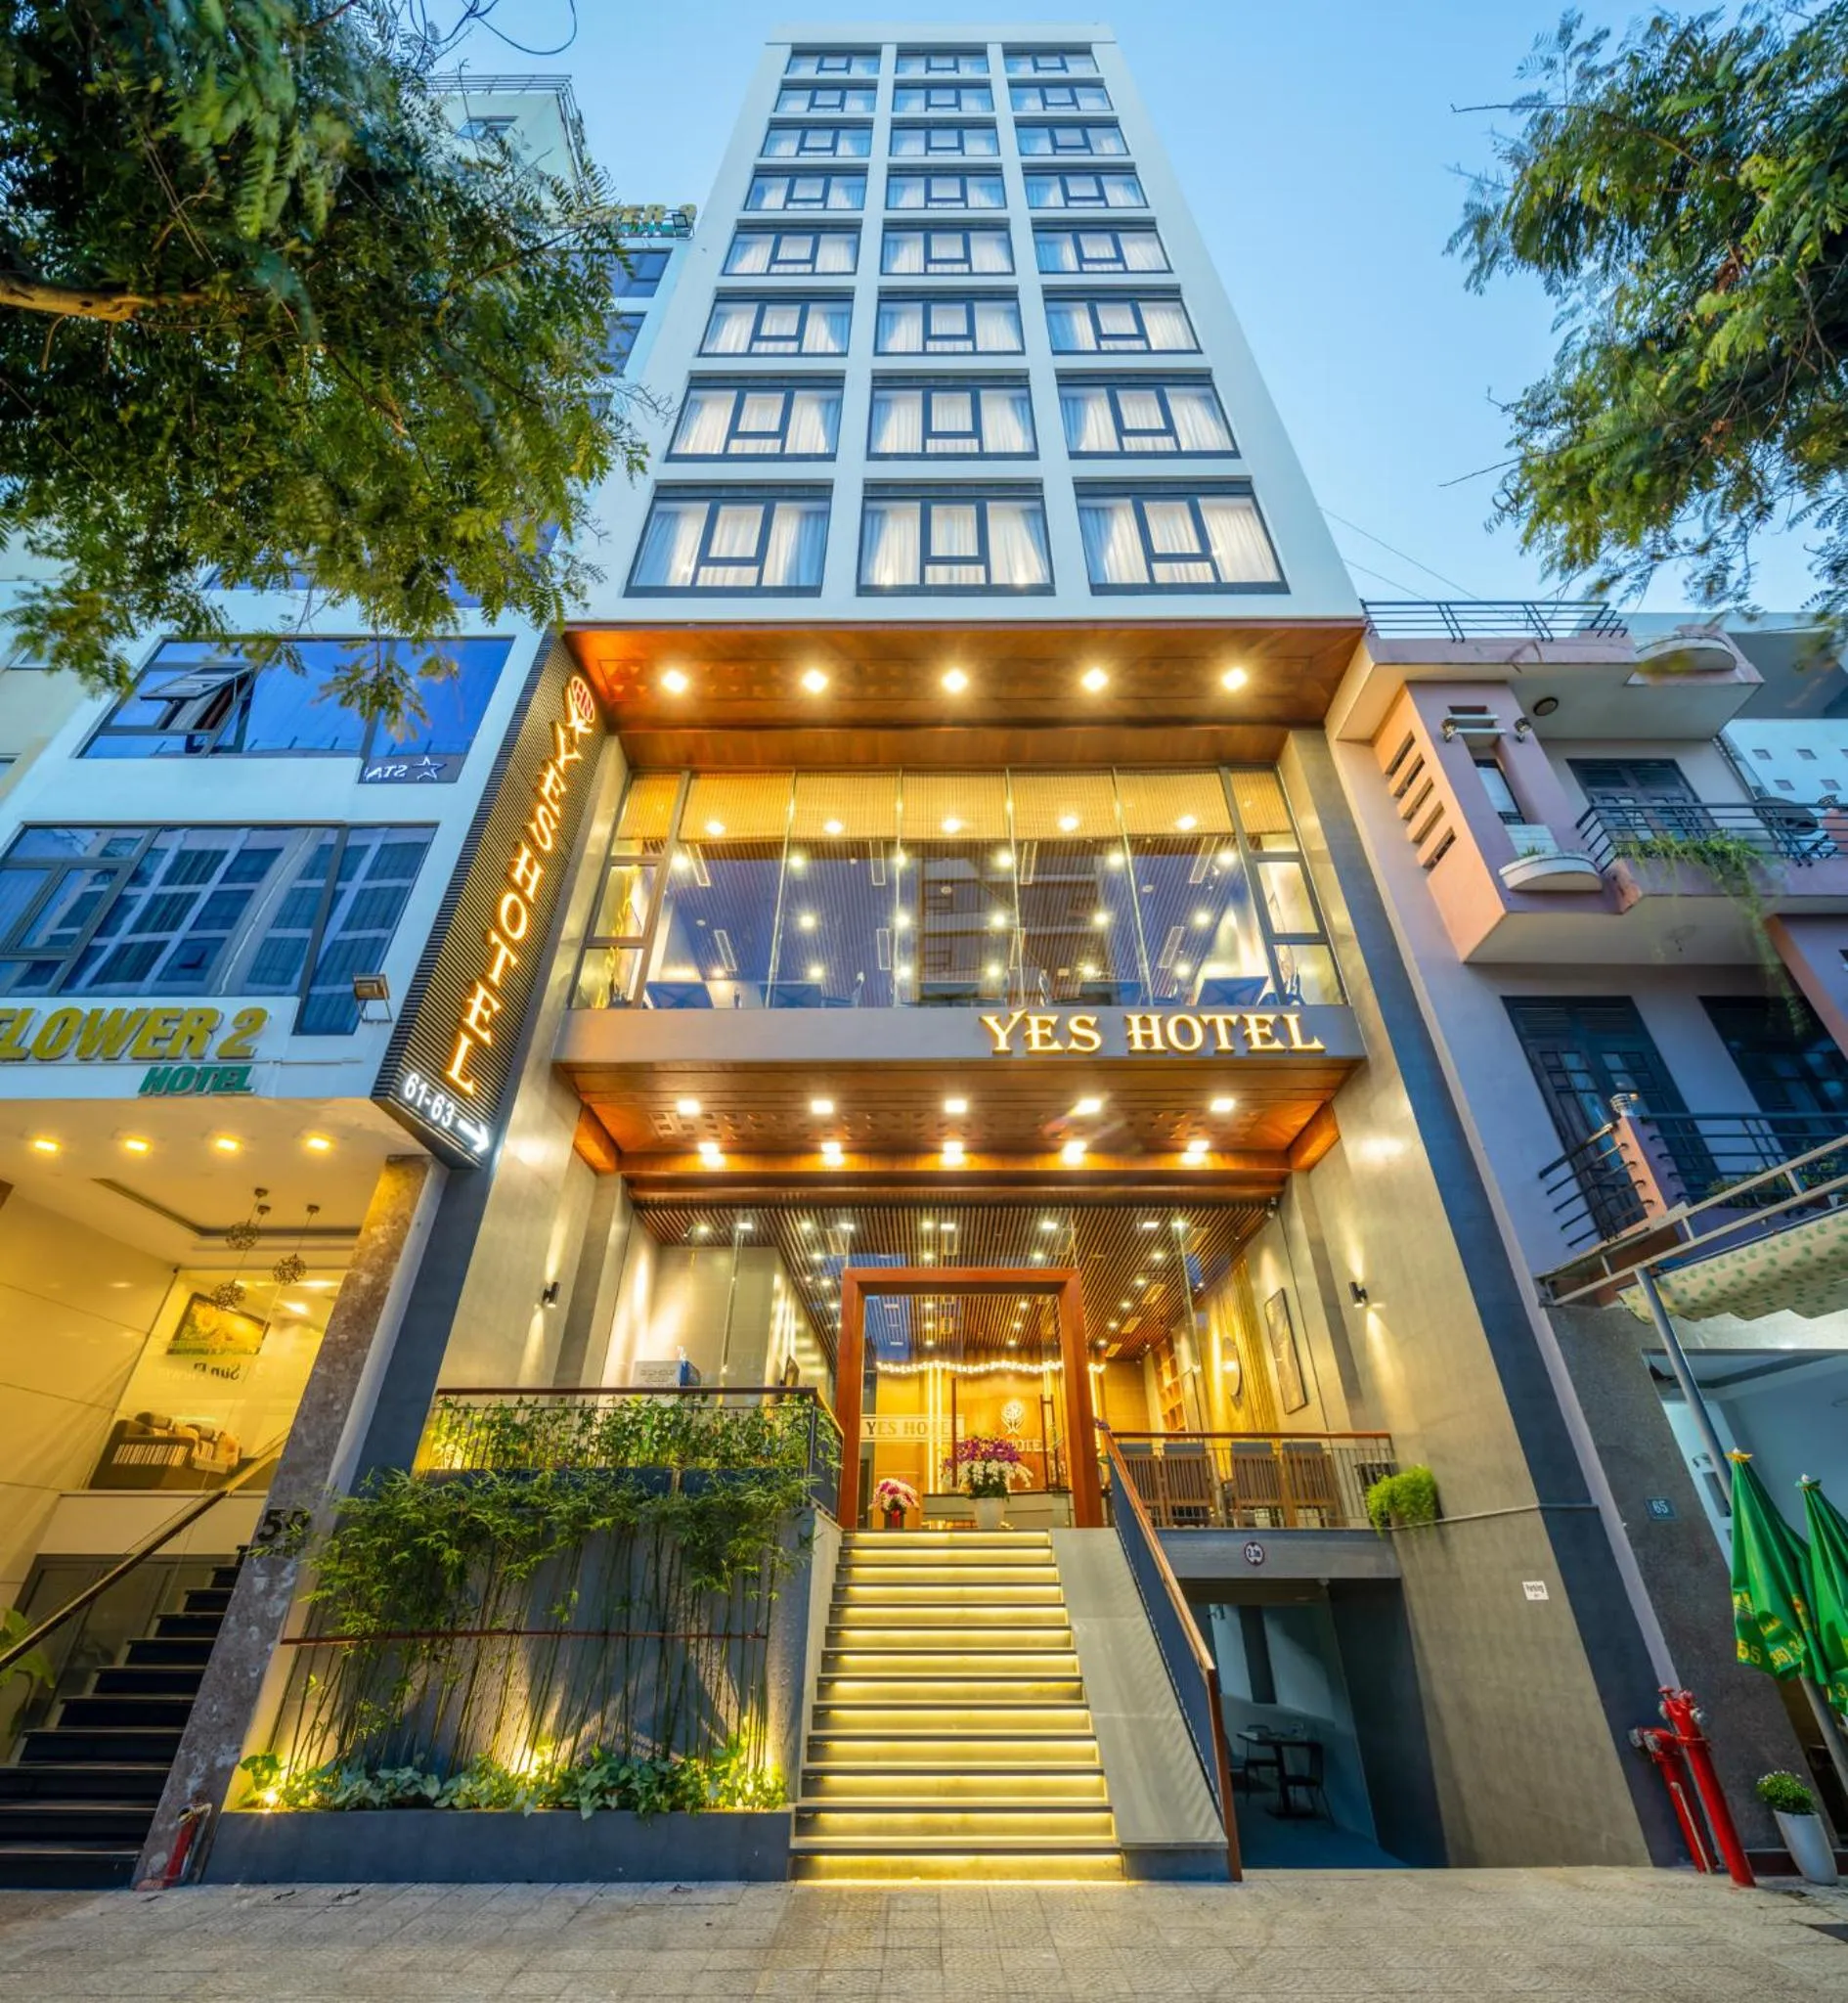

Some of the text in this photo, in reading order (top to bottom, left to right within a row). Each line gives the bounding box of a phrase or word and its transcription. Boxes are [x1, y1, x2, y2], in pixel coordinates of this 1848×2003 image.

[446, 720, 583, 1096] YES HOTEL
[216, 1007, 269, 1059] 2
[980, 1008, 1327, 1053] YES HOTEL
[138, 1064, 255, 1095] HOTEL
[403, 1072, 456, 1129] 61-63
[865, 1421, 897, 1435] YES
[1651, 1500, 1669, 1514] 65
